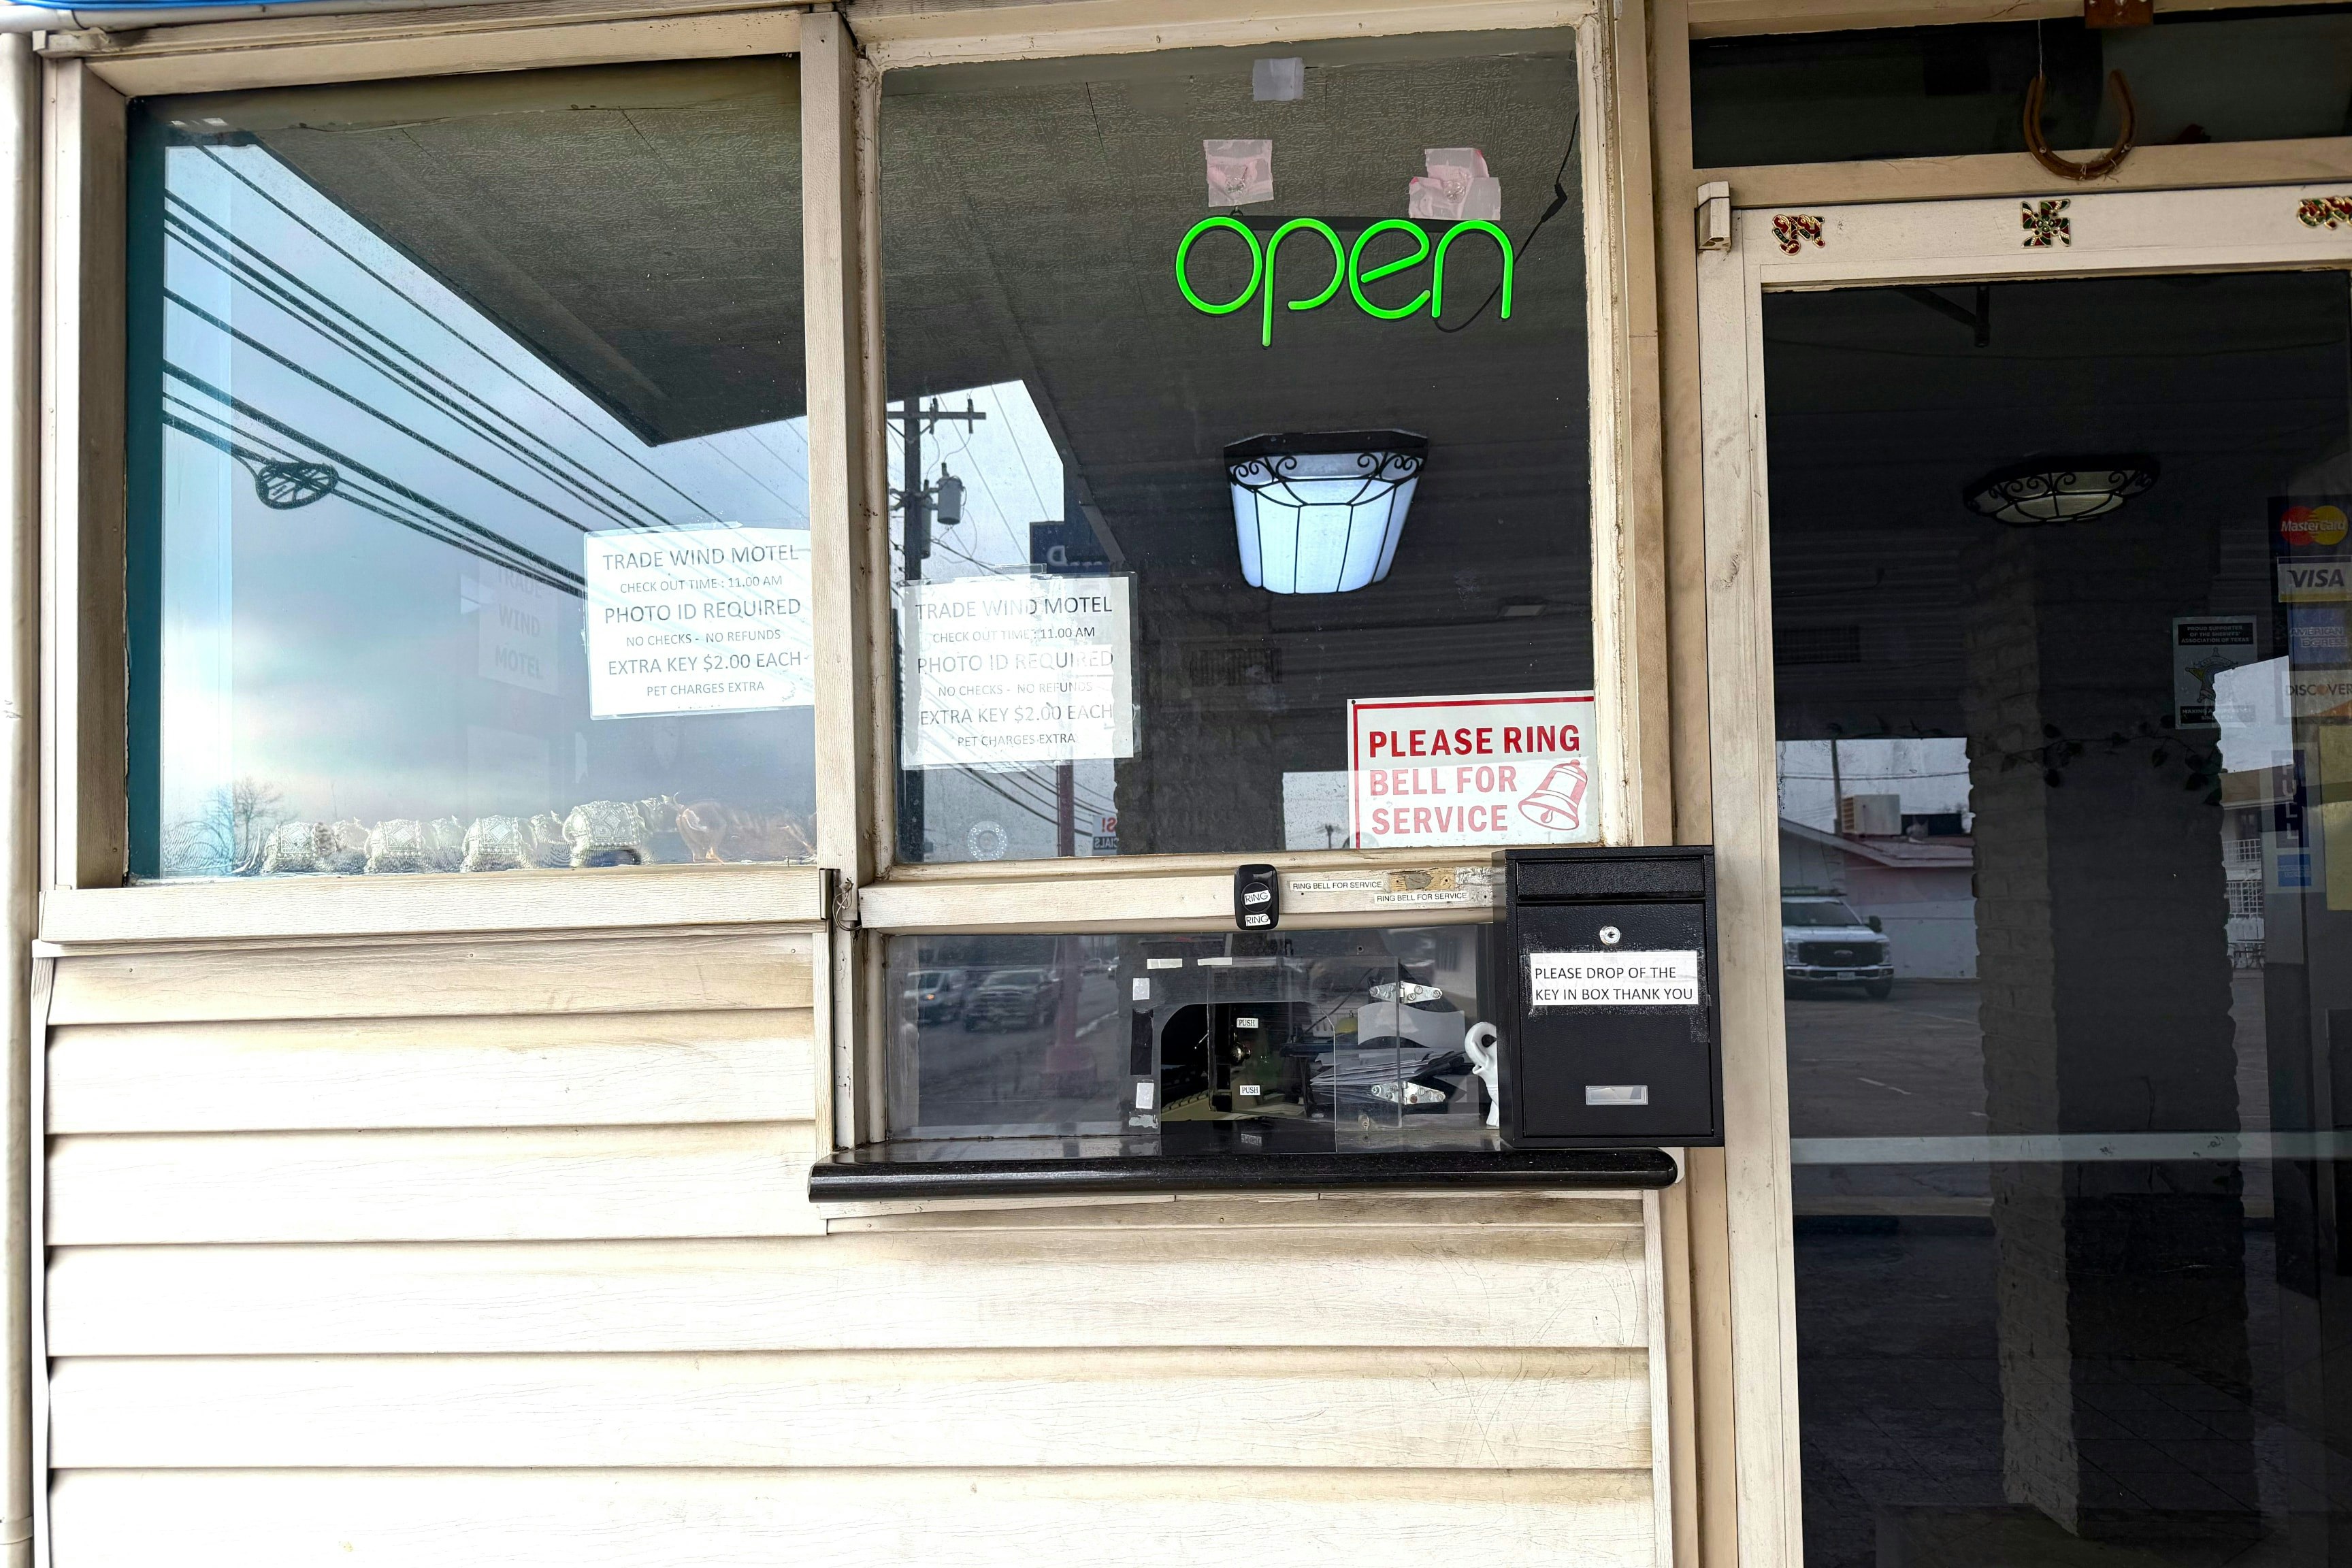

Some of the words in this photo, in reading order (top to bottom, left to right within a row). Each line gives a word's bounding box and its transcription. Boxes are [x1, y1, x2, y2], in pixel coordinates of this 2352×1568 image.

[1175, 216, 1514, 348] open
[2281, 519, 2348, 533] MasterCard
[603, 551, 664, 570] TRADE
[670, 549, 724, 566] WIND
[732, 545, 799, 564] MOTEL
[620, 581, 657, 593] CHECK
[660, 580, 687, 591] OUT
[689, 578, 717, 590] TIME
[728, 576, 760, 587] 11.00
[763, 576, 783, 586] AM
[2287, 569, 2345, 588] VISA
[605, 605, 670, 623] PHOTO
[679, 604, 697, 620] ID
[704, 598, 801, 619] REQUIRED
[915, 601, 977, 620] TRADE
[982, 599, 1037, 617] WIND
[1045, 596, 1113, 615] MOTEL
[499, 604, 540, 637] WIND
[627, 636, 644, 647] NO
[648, 634, 692, 645] CHECKS
[706, 632, 723, 643] NO
[728, 629, 781, 641] REFUNDS
[932, 630, 969, 643] CHECK
[973, 630, 998, 641] OUT
[1001, 629, 1030, 640] TIME
[1041, 628, 1072, 638] 11.00
[1075, 627, 1095, 638] AM
[2290, 626, 2344, 637] AMERICAN
[2301, 637, 2349, 648] EXPRESS
[608, 659, 662, 675] EXTRA
[667, 657, 698, 672] KEY
[704, 653, 751, 673] $2.00
[756, 651, 801, 668] EACH
[917, 655, 982, 674] PHOTO
[990, 655, 1009, 670] ID
[1015, 650, 1113, 670] REQUIRED
[647, 686, 667, 696] PET
[670, 683, 724, 695] CHARGES
[728, 681, 764, 693] EXTRA
[938, 686, 956, 697] NO
[959, 685, 1003, 696] CHECKS
[1017, 683, 1034, 693] NO
[1039, 681, 1092, 693] REFUNDS
[920, 709, 973, 726] EXTRA
[979, 708, 1009, 723] KEY
[1014, 704, 1062, 723] $2.00
[1068, 704, 1113, 720] EACH
[958, 736, 978, 747] PET
[981, 734, 1035, 747] CHARGES
[1039, 734, 1075, 744] EXTRA
[1369, 728, 1494, 758] PLEASE
[1503, 724, 1580, 754] RING
[1370, 768, 1446, 797] BELL
[1457, 766, 1517, 794] FOR
[1371, 804, 1508, 835] SERVICE
[1245, 892, 1269, 904] RING
[1246, 915, 1269, 924] RING
[1535, 968, 1582, 979] PLEASE
[1587, 968, 1624, 979] DROP
[1629, 967, 1646, 978] OF
[1650, 967, 1676, 978] THE
[1536, 989, 1559, 1000] KEY
[1564, 989, 1577, 1000] IN
[1582, 988, 1610, 1000] BOX
[1613, 988, 1660, 1000] THANK
[1663, 988, 1693, 1000] YOU
